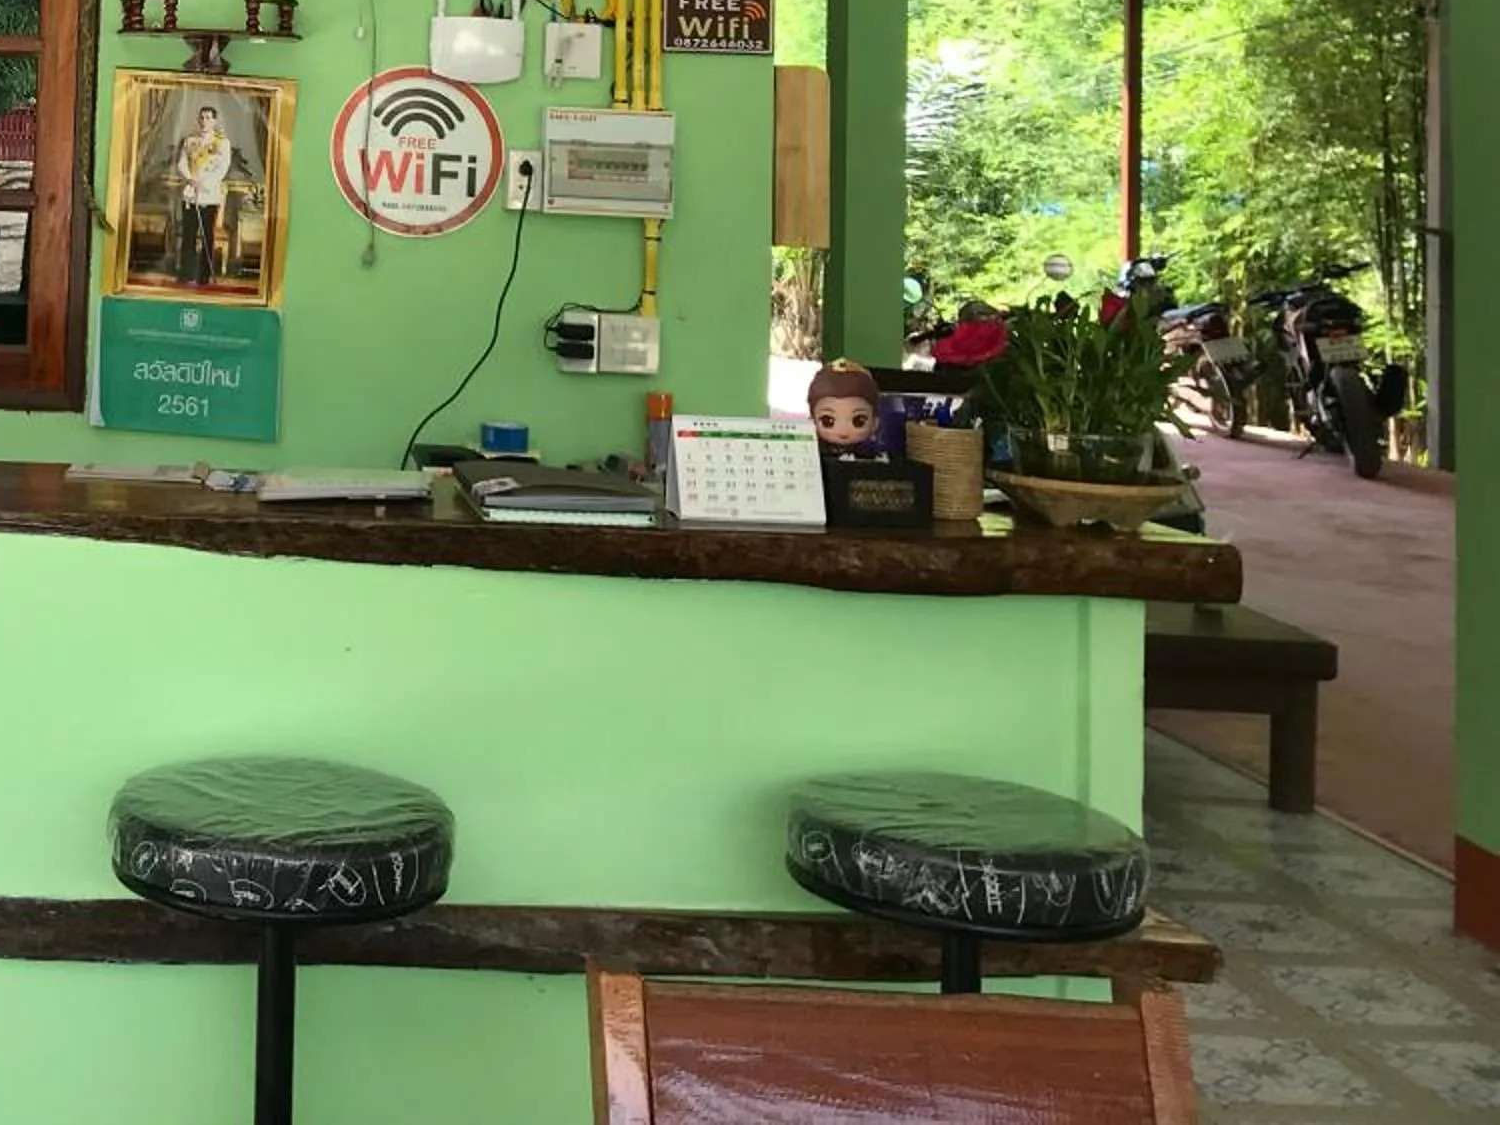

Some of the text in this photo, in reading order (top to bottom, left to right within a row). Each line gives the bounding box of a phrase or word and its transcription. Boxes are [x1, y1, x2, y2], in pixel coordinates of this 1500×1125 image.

[398, 137, 437, 150] FREE
[359, 148, 478, 198] WiFi
[157, 394, 210, 418] 2561
